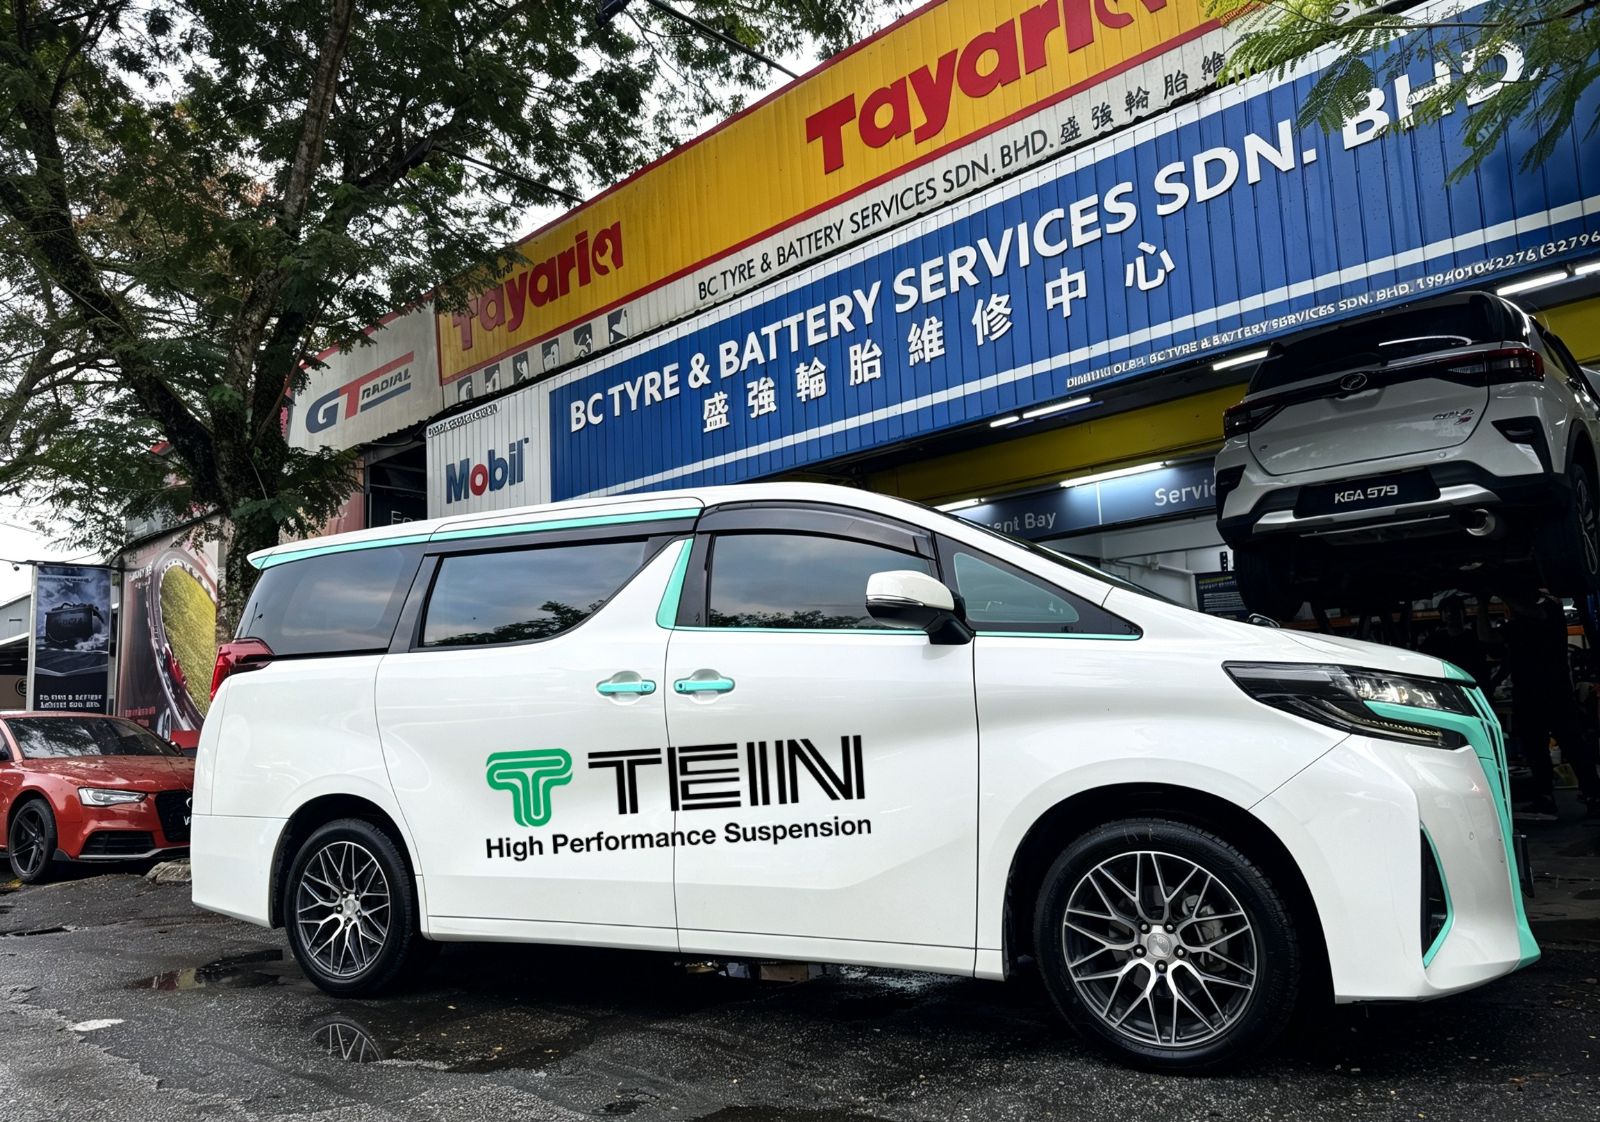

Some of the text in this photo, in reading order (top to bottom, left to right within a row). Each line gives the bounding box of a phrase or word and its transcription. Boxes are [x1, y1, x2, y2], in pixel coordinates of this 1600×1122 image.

[698, 128, 1055, 301] BC TYRE & BATTERY SERVICES SDN. BHD.
[453, 221, 623, 350] Tayaria
[570, 392, 603, 433] BC
[607, 362, 680, 417] TYRE
[688, 352, 712, 389] &
[719, 280, 881, 378] BATTERY
[893, 181, 1137, 313] SERVICES
[1154, 119, 1317, 216] SDN.
[703, 241, 1175, 433] 盛強輪胎維修中心
[361, 368, 412, 400] RADIAL
[446, 438, 524, 504] Mobil
[1334, 485, 1398, 504] KGA 579
[987, 512, 1056, 533] ent Bay
[588, 735, 866, 815] TEIN
[486, 816, 872, 862] High Performance Suspension
